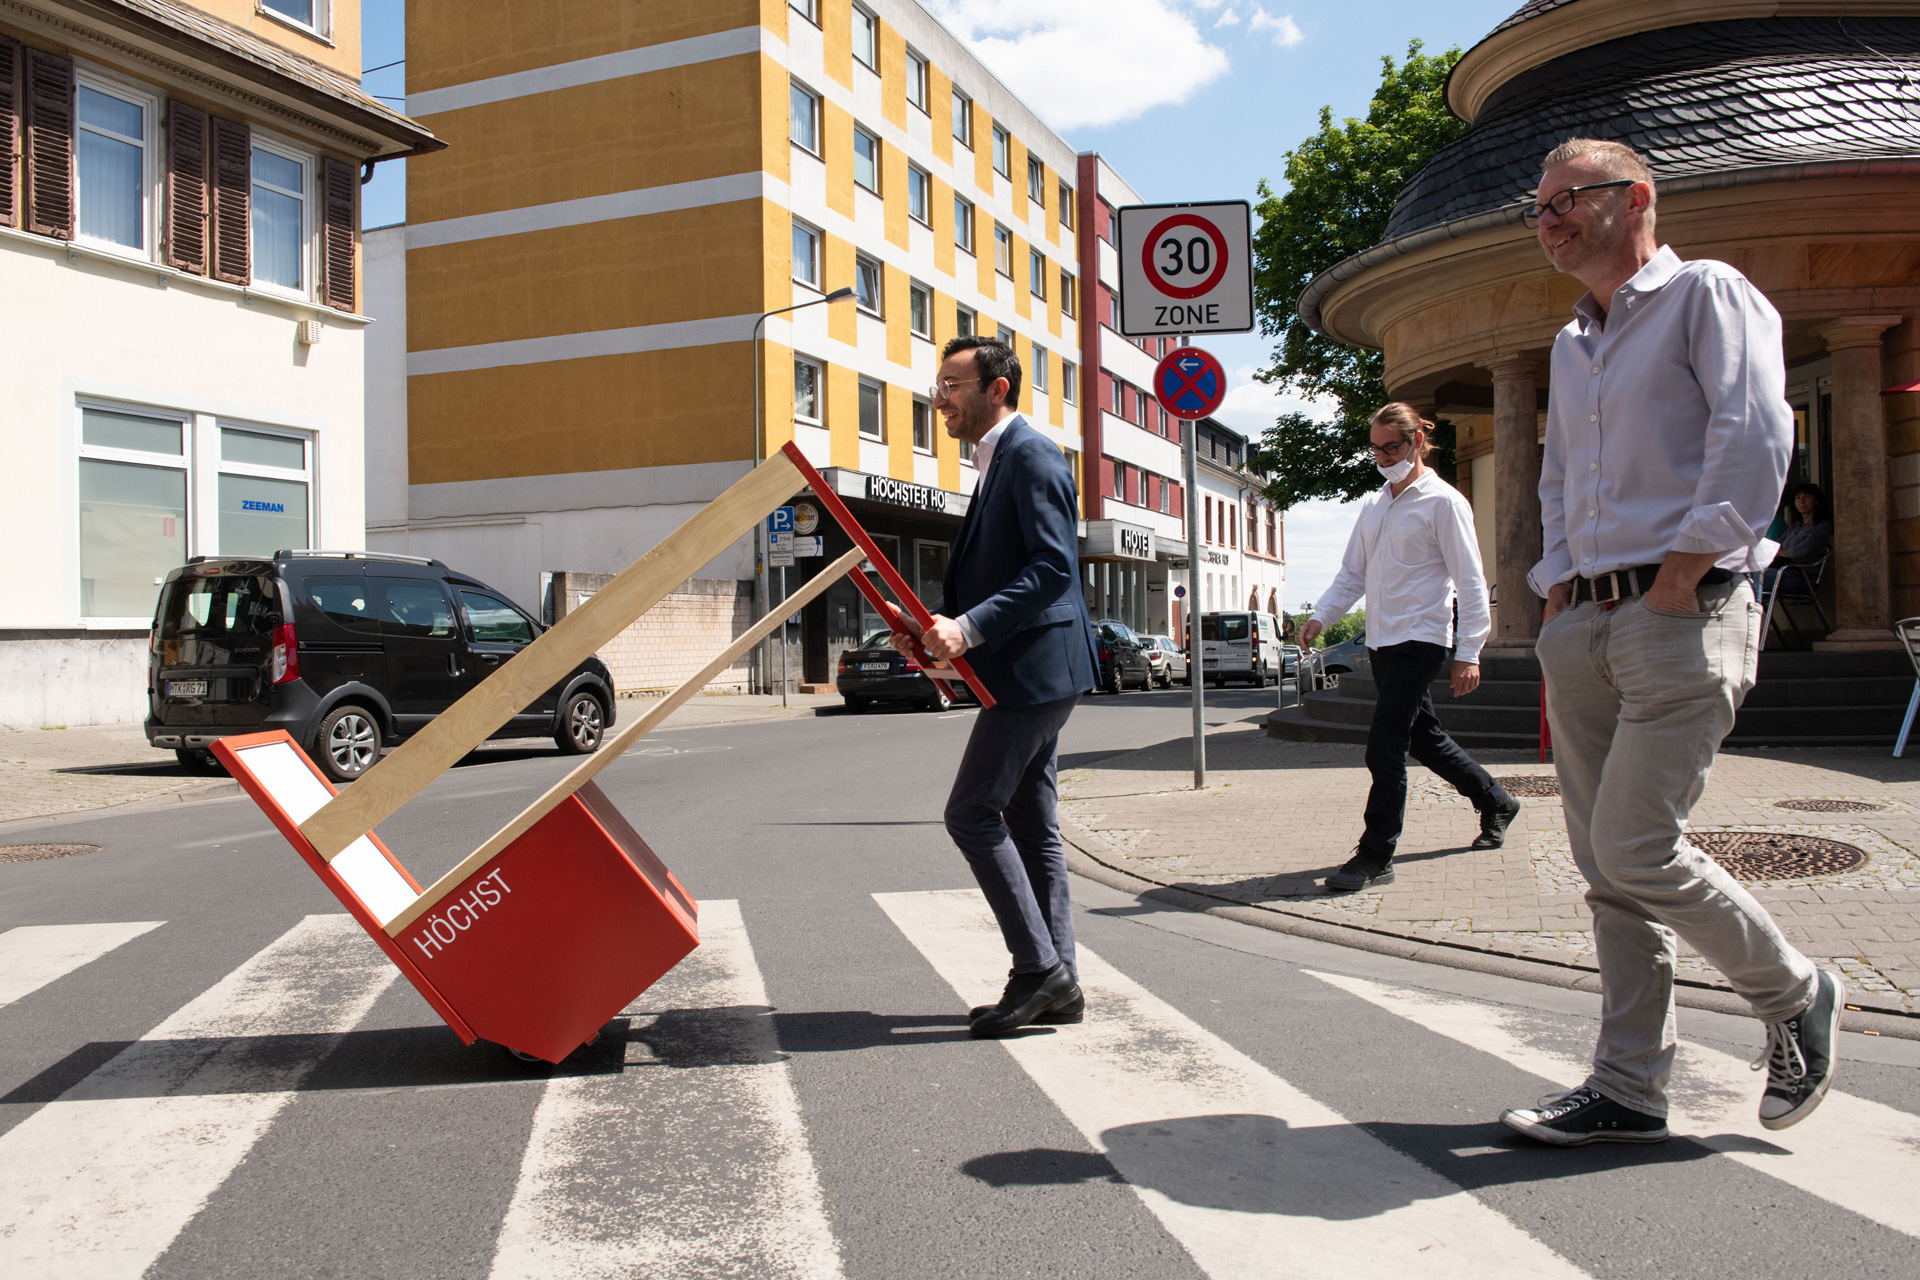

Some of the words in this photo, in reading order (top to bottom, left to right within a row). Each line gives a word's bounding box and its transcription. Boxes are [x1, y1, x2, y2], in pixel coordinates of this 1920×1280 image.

[1160, 237, 1210, 276] 30
[1154, 303, 1220, 326] ZONE
[871, 475, 928, 507] HÖCHSTER
[242, 500, 284, 513] ZEEMAN
[197, 682, 206, 694] 71
[413, 867, 511, 959] HÖCHST
